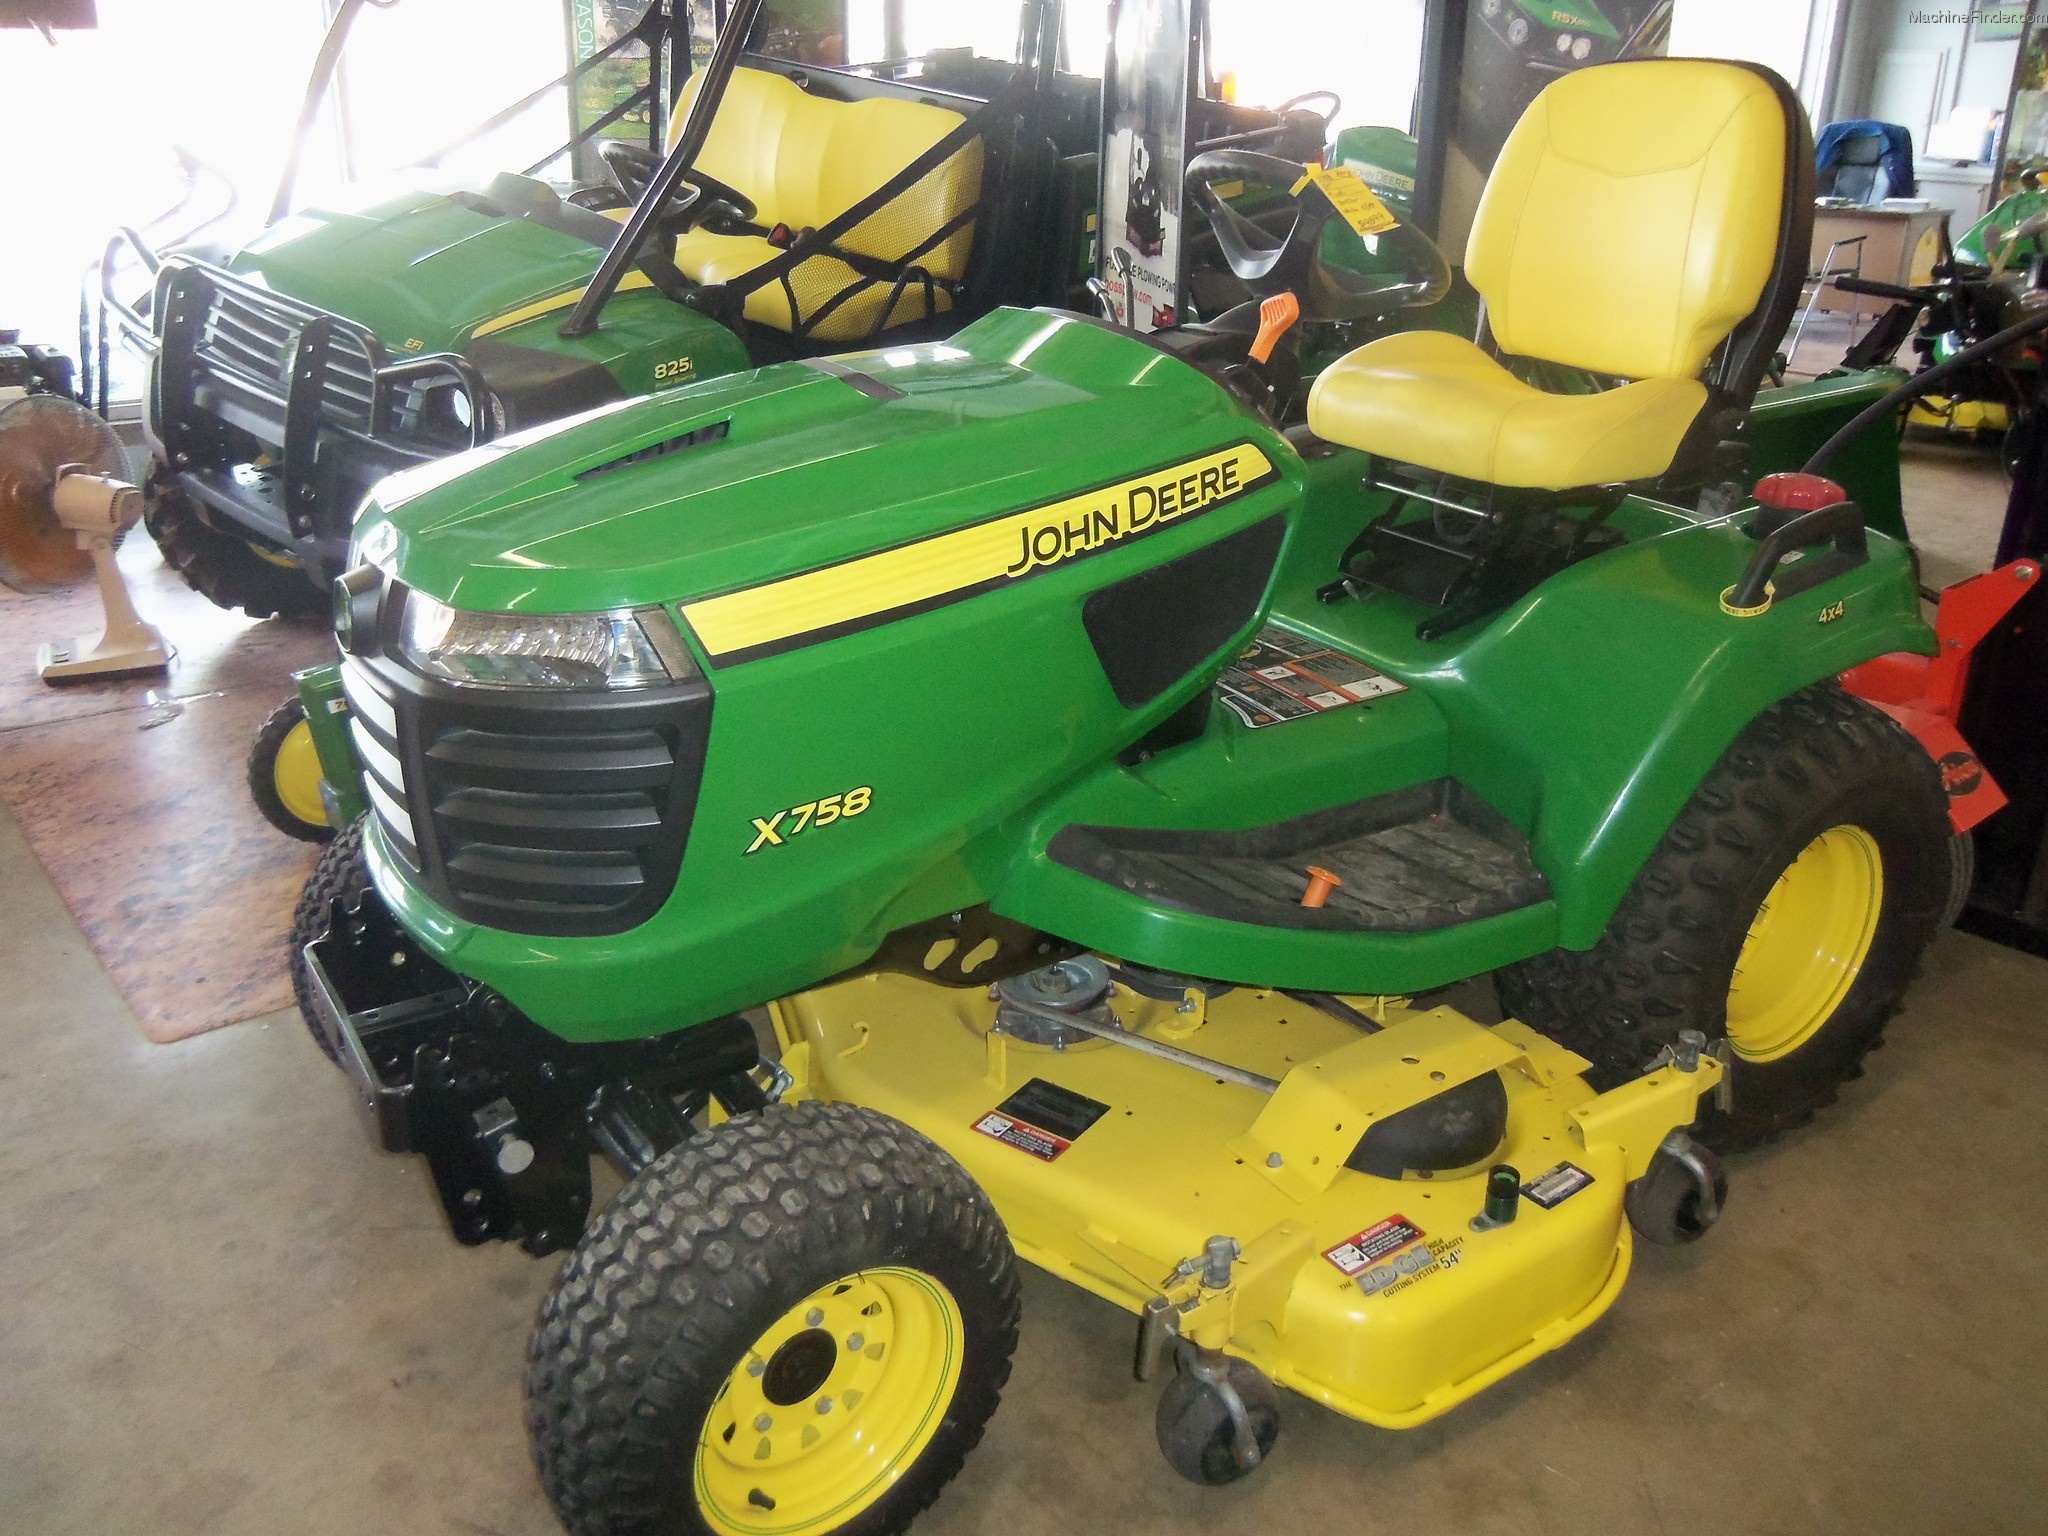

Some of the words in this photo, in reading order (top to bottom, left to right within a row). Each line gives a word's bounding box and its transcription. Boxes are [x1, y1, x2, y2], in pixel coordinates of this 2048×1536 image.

[577, 0, 594, 58] ASON
[1375, 171, 1409, 190] DEERE
[404, 337, 425, 351] EFI
[654, 356, 693, 379] 825i
[1007, 503, 1119, 574] JOHN
[1128, 457, 1241, 529] DEERE
[1818, 600, 1844, 624] 4x4
[744, 786, 872, 854] X758
[1427, 1237, 1445, 1250] HIGH
[1433, 1236, 1464, 1256] CAPACITY
[1339, 1280, 1354, 1292] THE
[1383, 1278, 1414, 1298] CUTTING
[1413, 1263, 1442, 1286] SYSTEM
